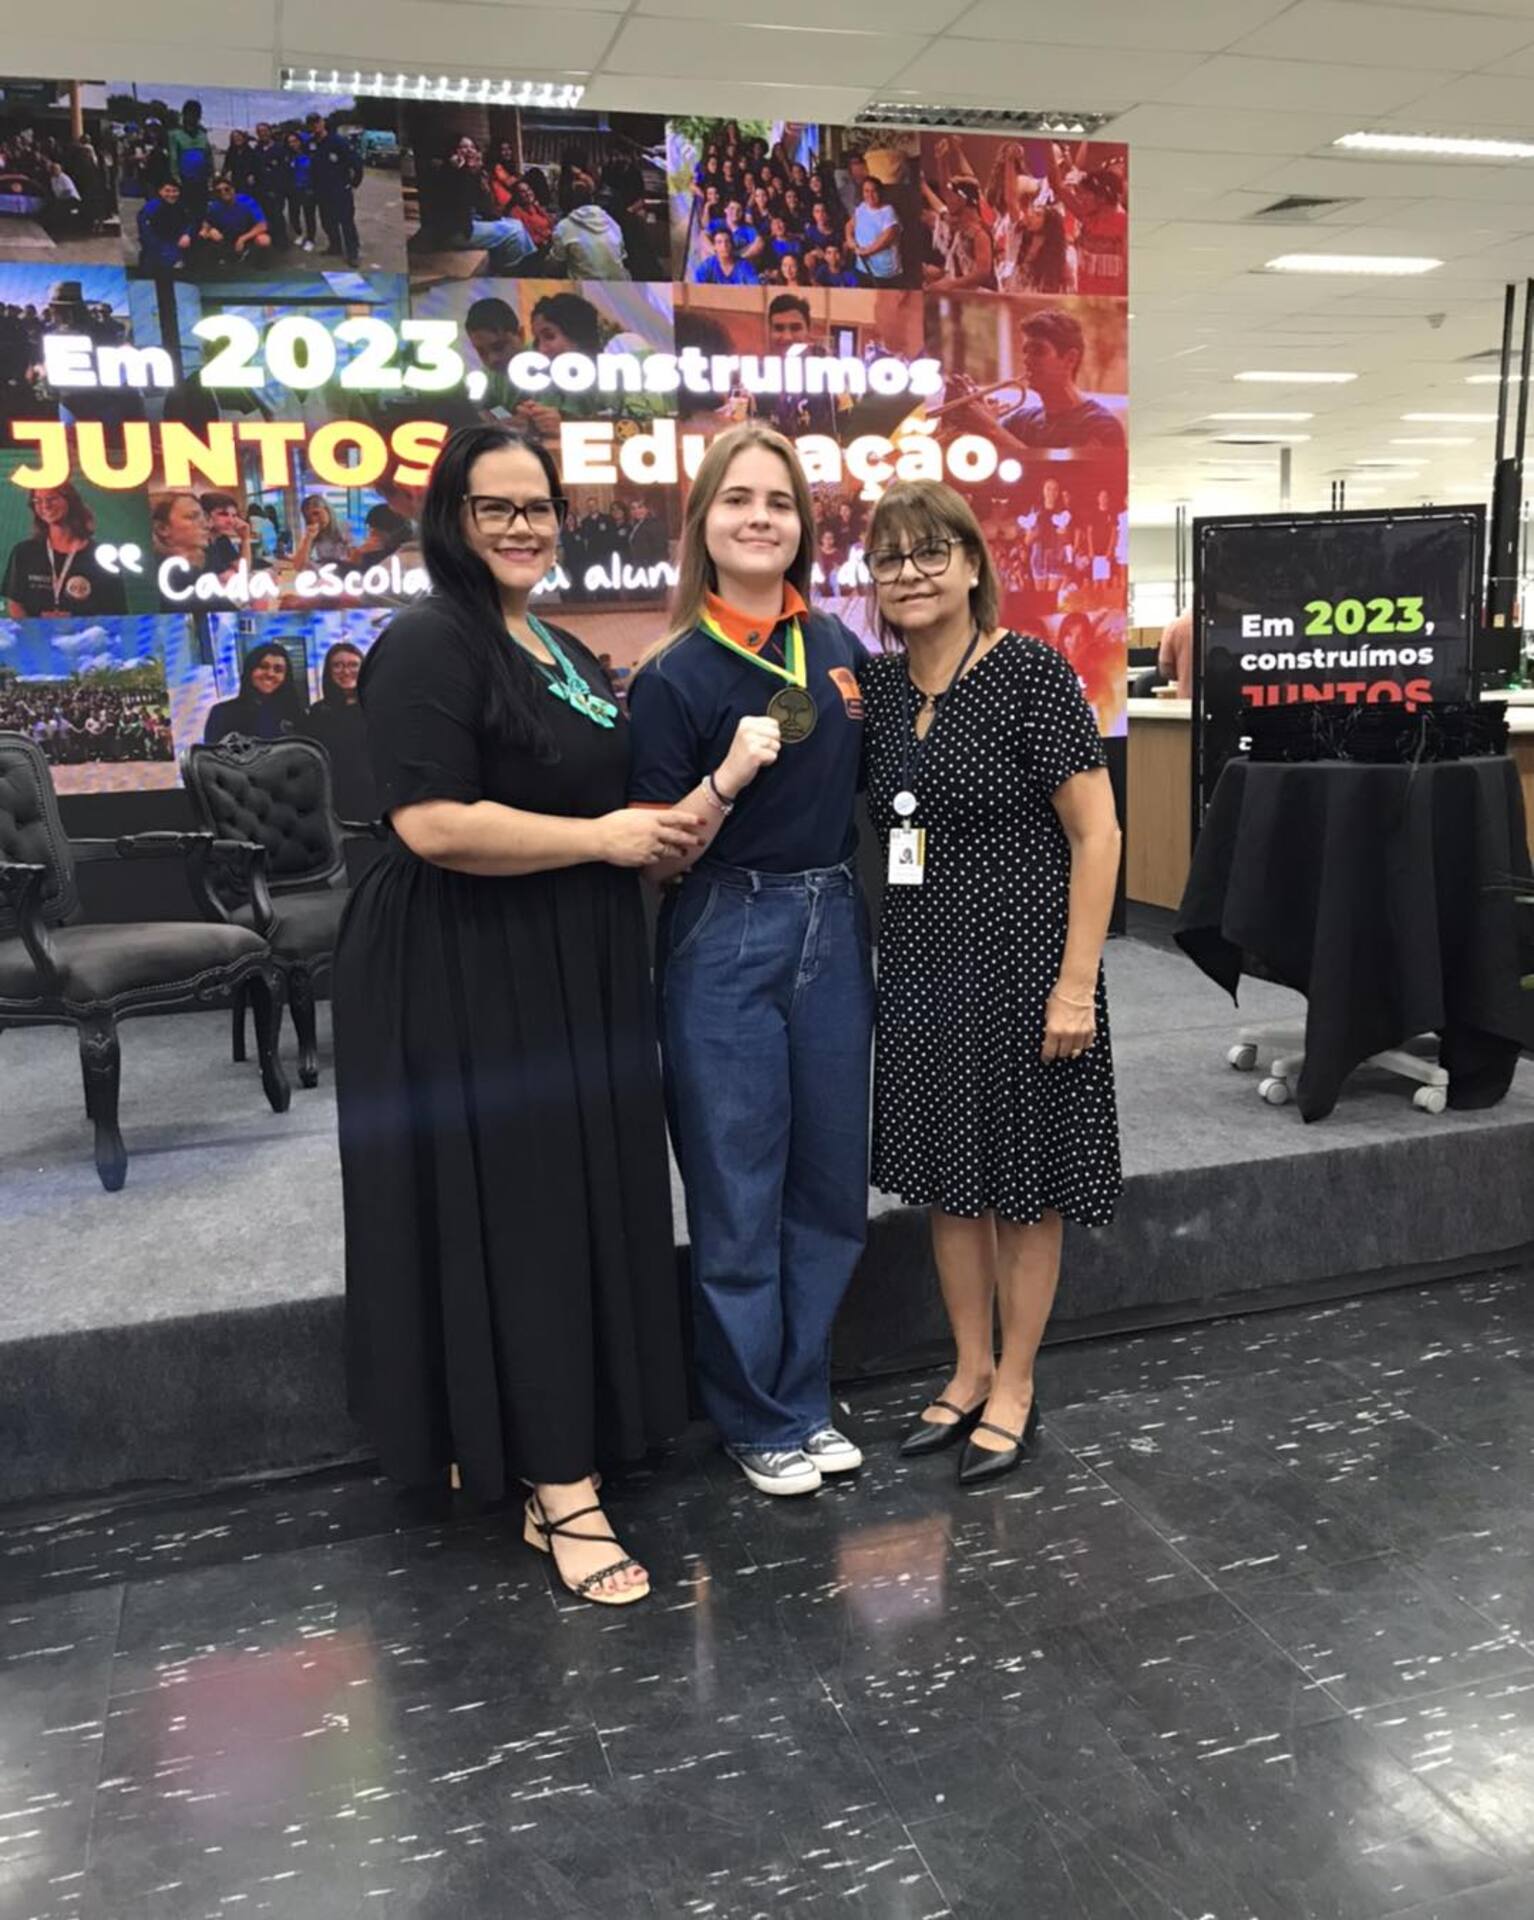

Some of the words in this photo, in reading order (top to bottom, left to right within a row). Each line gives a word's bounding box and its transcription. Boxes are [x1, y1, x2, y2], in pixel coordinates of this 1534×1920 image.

[43, 335, 174, 387] Em
[192, 314, 487, 400] 2023,
[507, 346, 942, 394] construímos
[9, 421, 449, 489] JUNTOS
[158, 556, 278, 602] Cada
[584, 551, 681, 591] alun
[1241, 615, 1294, 637] Em
[1304, 597, 1435, 635] 2023,
[1240, 645, 1434, 671] construímos
